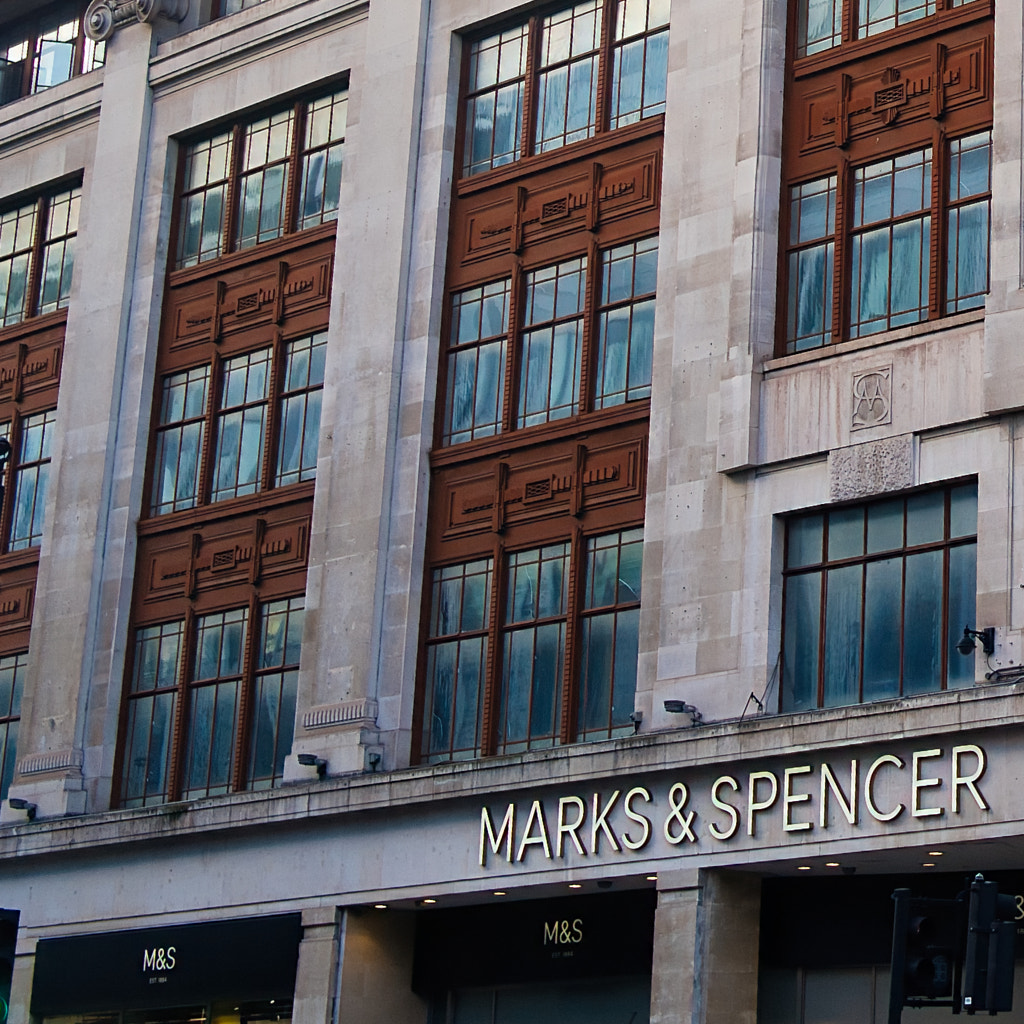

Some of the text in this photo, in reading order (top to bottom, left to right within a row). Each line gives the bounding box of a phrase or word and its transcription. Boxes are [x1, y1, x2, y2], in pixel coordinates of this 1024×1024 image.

[478, 744, 991, 867] MARKS & SPENCER
[543, 918, 583, 946] M&S
[142, 946, 177, 972] M&S
